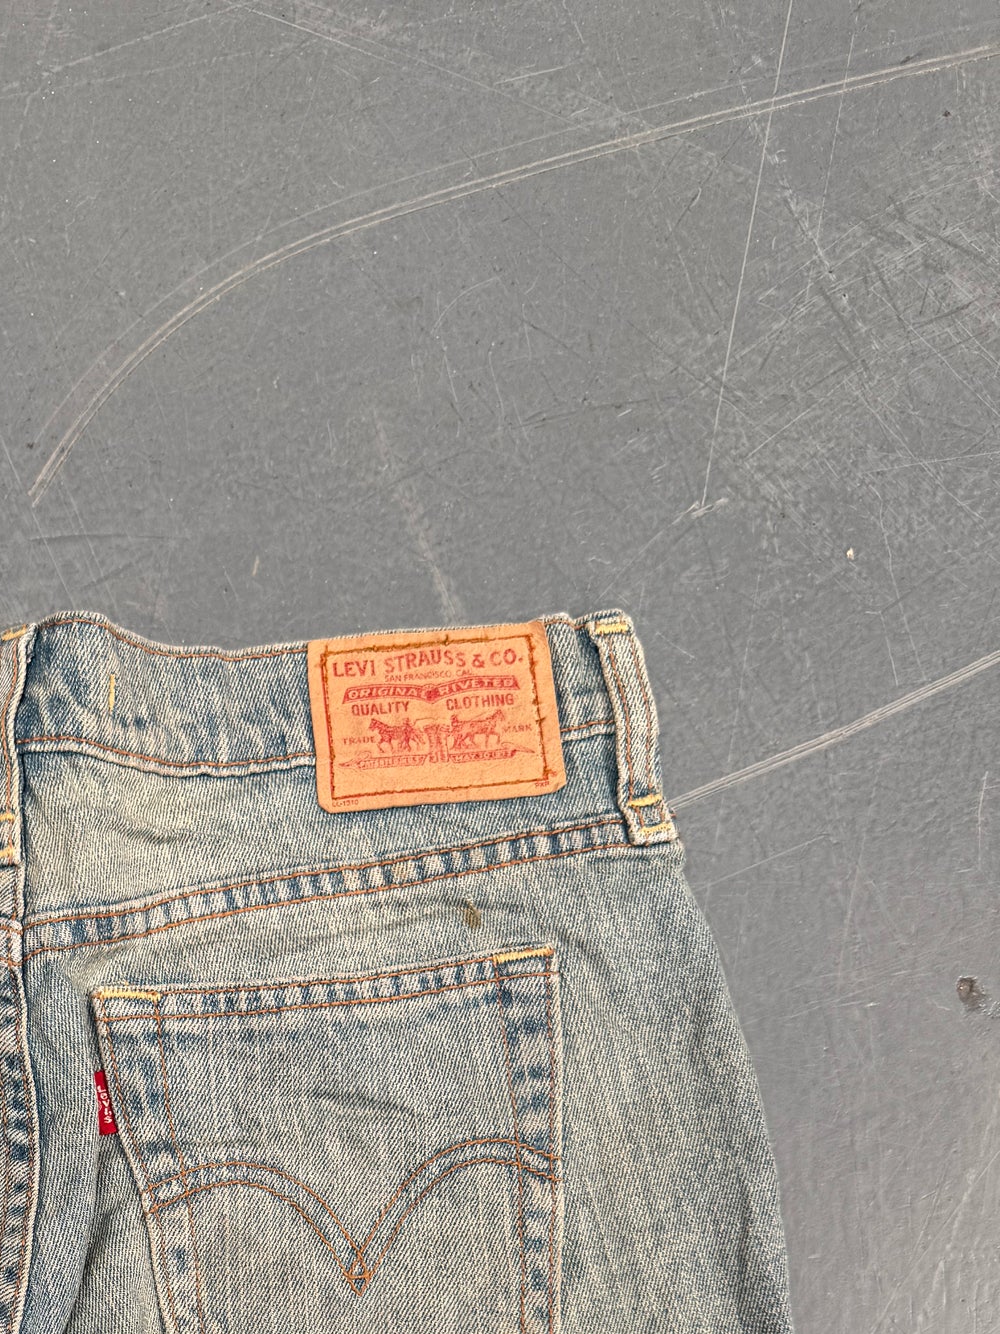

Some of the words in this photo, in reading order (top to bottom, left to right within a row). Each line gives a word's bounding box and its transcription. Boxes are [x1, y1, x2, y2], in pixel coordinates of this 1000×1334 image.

[332, 660, 376, 677] LEVI
[384, 649, 466, 673] STRAUSS
[472, 653, 485, 668] &
[490, 648, 524, 666] CO.
[384, 674, 402, 683] SAN
[438, 679, 514, 696] RIVETED
[351, 701, 410, 716] QUALITY
[446, 693, 515, 711] CLOTHING
[343, 736, 377, 745] TRADE
[502, 723, 533, 733] MARK
